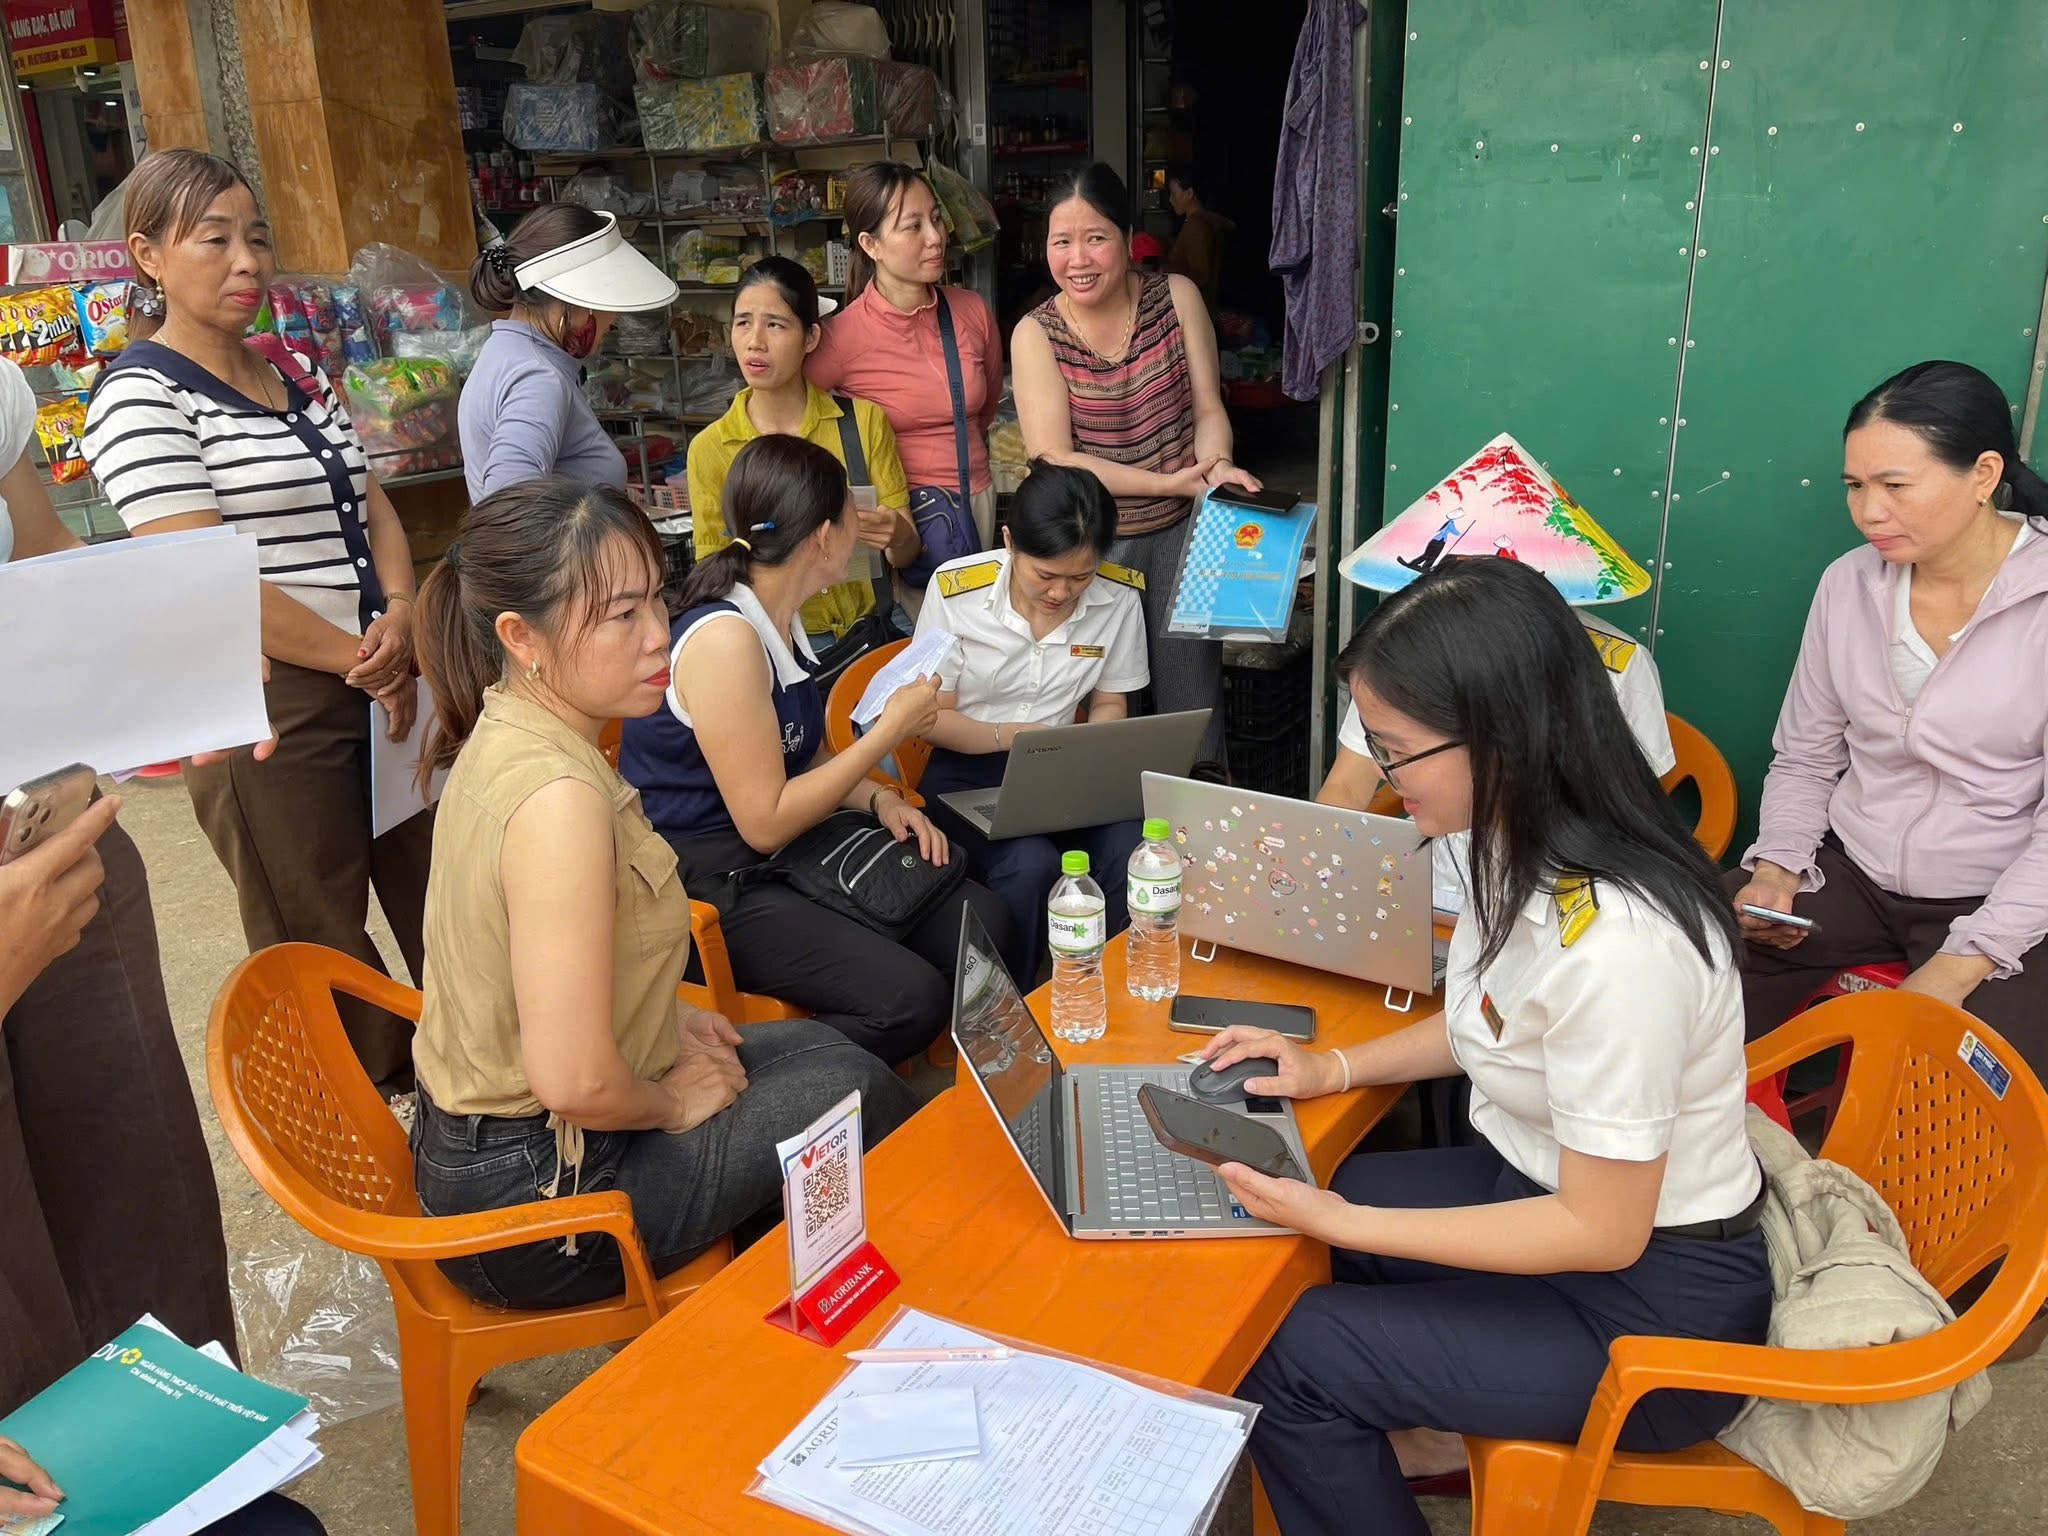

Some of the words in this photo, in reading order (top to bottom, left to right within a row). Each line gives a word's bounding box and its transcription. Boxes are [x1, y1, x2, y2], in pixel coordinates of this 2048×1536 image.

[58, 249, 131, 270] ORIO
[801, 1129, 847, 1169] VIETQR
[829, 1263, 874, 1306] AGRIBANK
[139, 1359, 157, 1371] NGÂN
[153, 1367, 172, 1379] HÀNG
[253, 1413, 270, 1422] NAM
